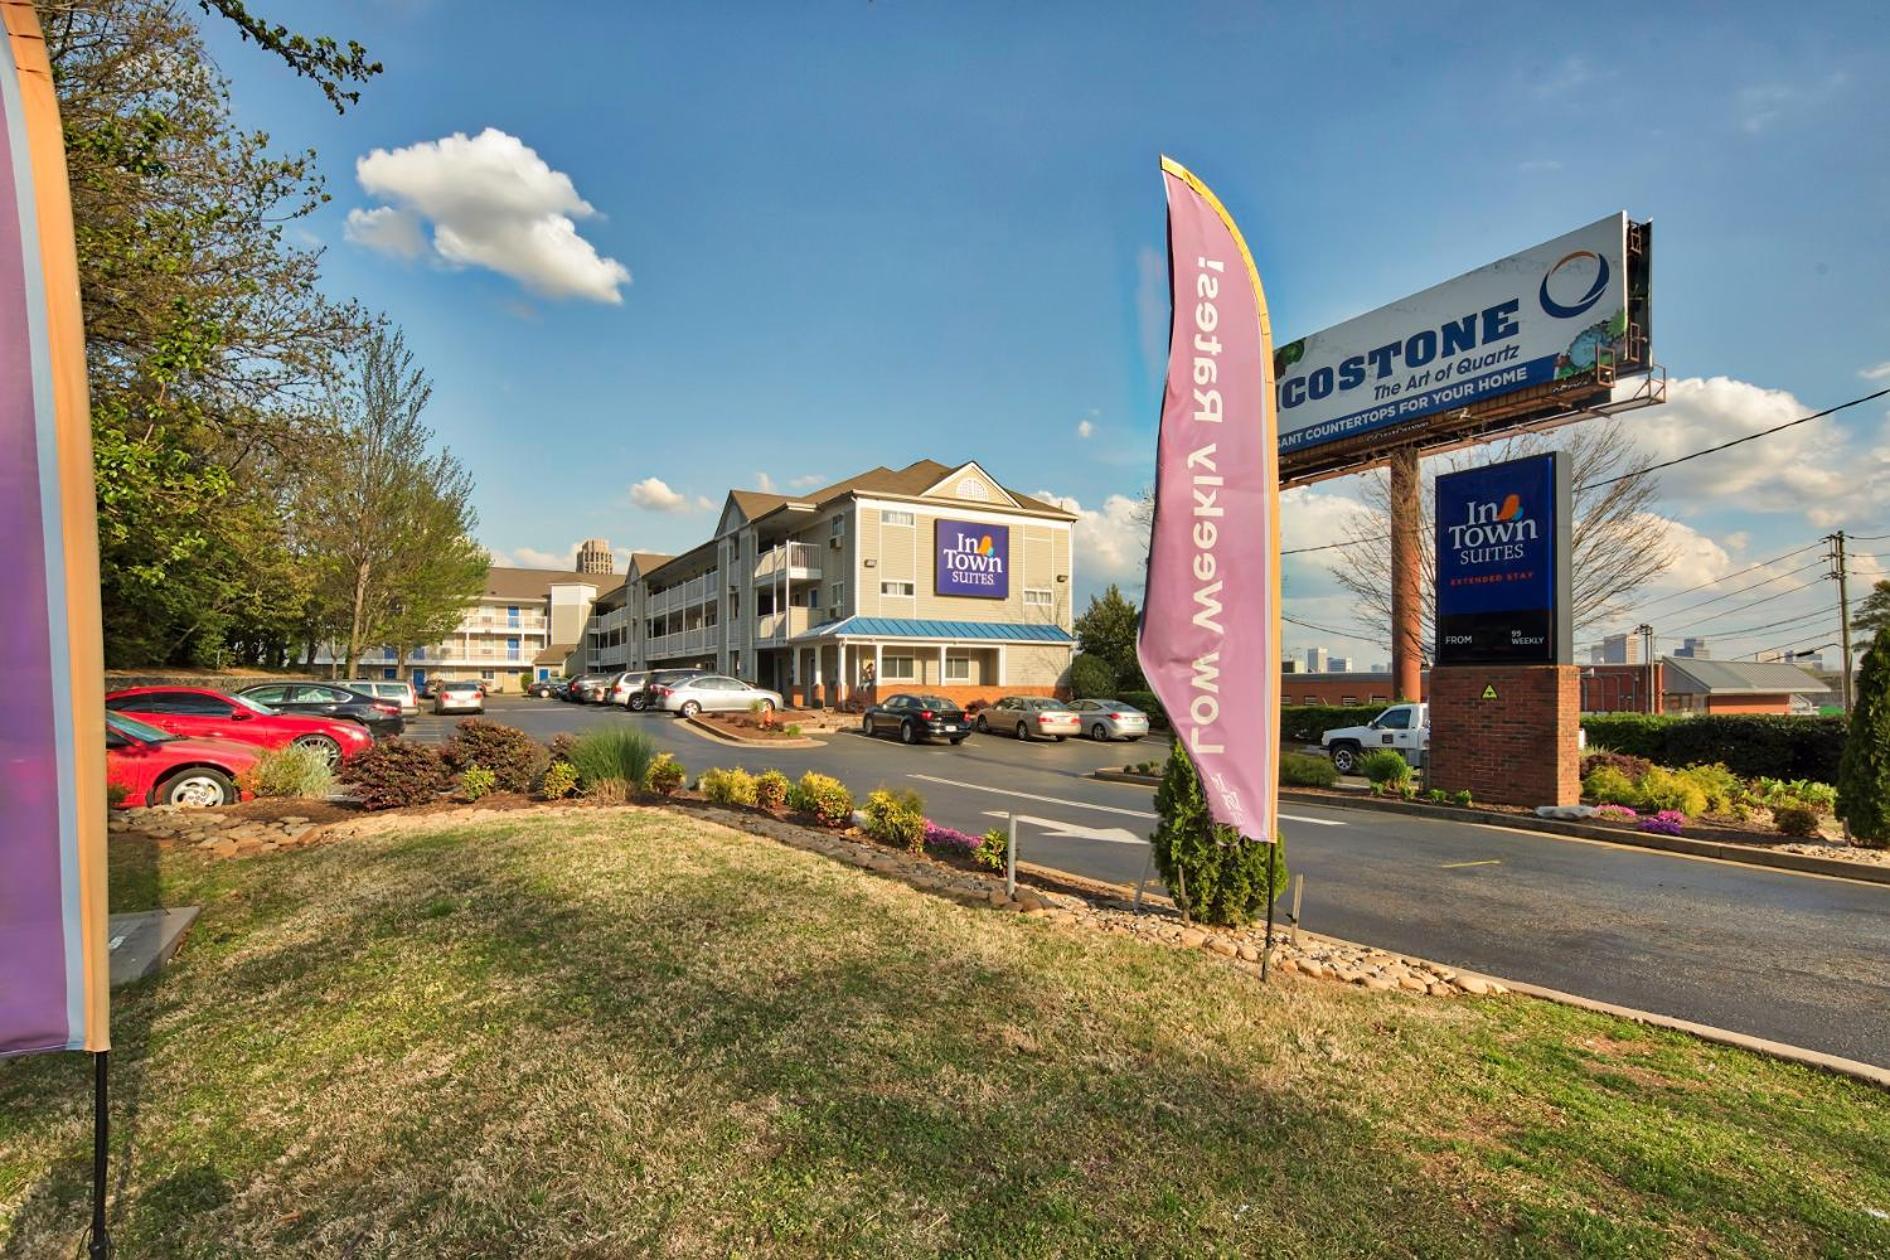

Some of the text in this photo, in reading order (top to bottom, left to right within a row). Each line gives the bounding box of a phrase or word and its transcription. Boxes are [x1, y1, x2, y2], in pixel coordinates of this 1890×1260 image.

[1276, 298, 1519, 412] COSTONE
[1374, 344, 1521, 401] The Art of Quartz
[1305, 405, 1396, 440] COUNTERTOPS
[1400, 396, 1429, 415] FOR
[1431, 383, 1475, 405] YOUR
[1478, 366, 1529, 393] HOME
[1467, 499, 1499, 525] In
[957, 533, 979, 554] In
[1449, 519, 1538, 550] Town
[943, 548, 1003, 573] Town
[1459, 543, 1525, 566] SUITES
[952, 571, 994, 586] SUITES
[1445, 635, 1473, 645] FROM
[1511, 636, 1545, 645] WEEKLY
